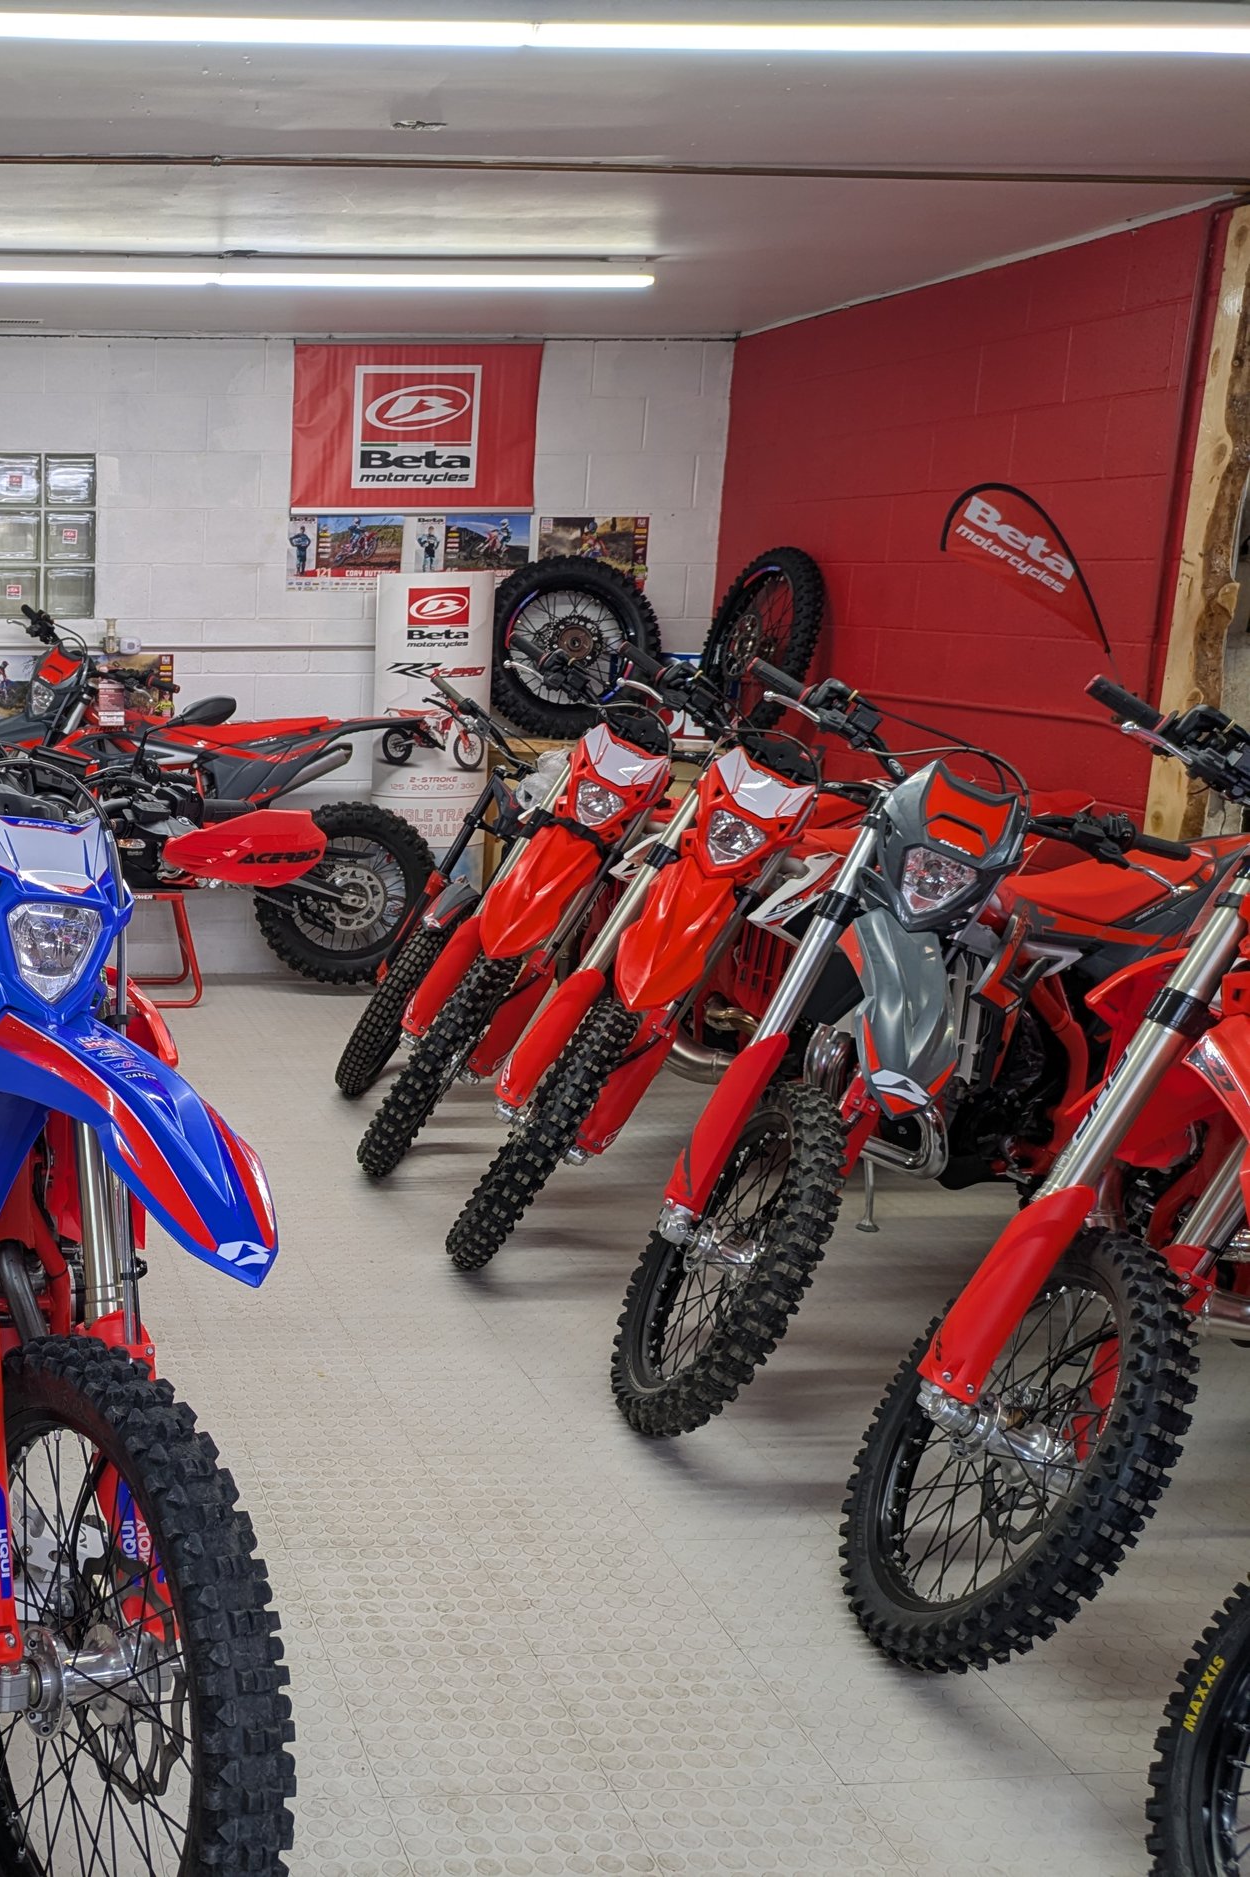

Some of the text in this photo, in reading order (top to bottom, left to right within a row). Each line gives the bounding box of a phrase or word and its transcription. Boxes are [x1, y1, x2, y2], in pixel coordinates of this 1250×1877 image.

[360, 450, 471, 469] Beta
[359, 472, 470, 485] motorcycles
[963, 495, 1076, 581] Beta
[956, 524, 1066, 593] motorcycles
[316, 568, 331, 577] 121
[407, 629, 469, 640] Beta
[1182, 1654, 1227, 1734] MAXXIS
